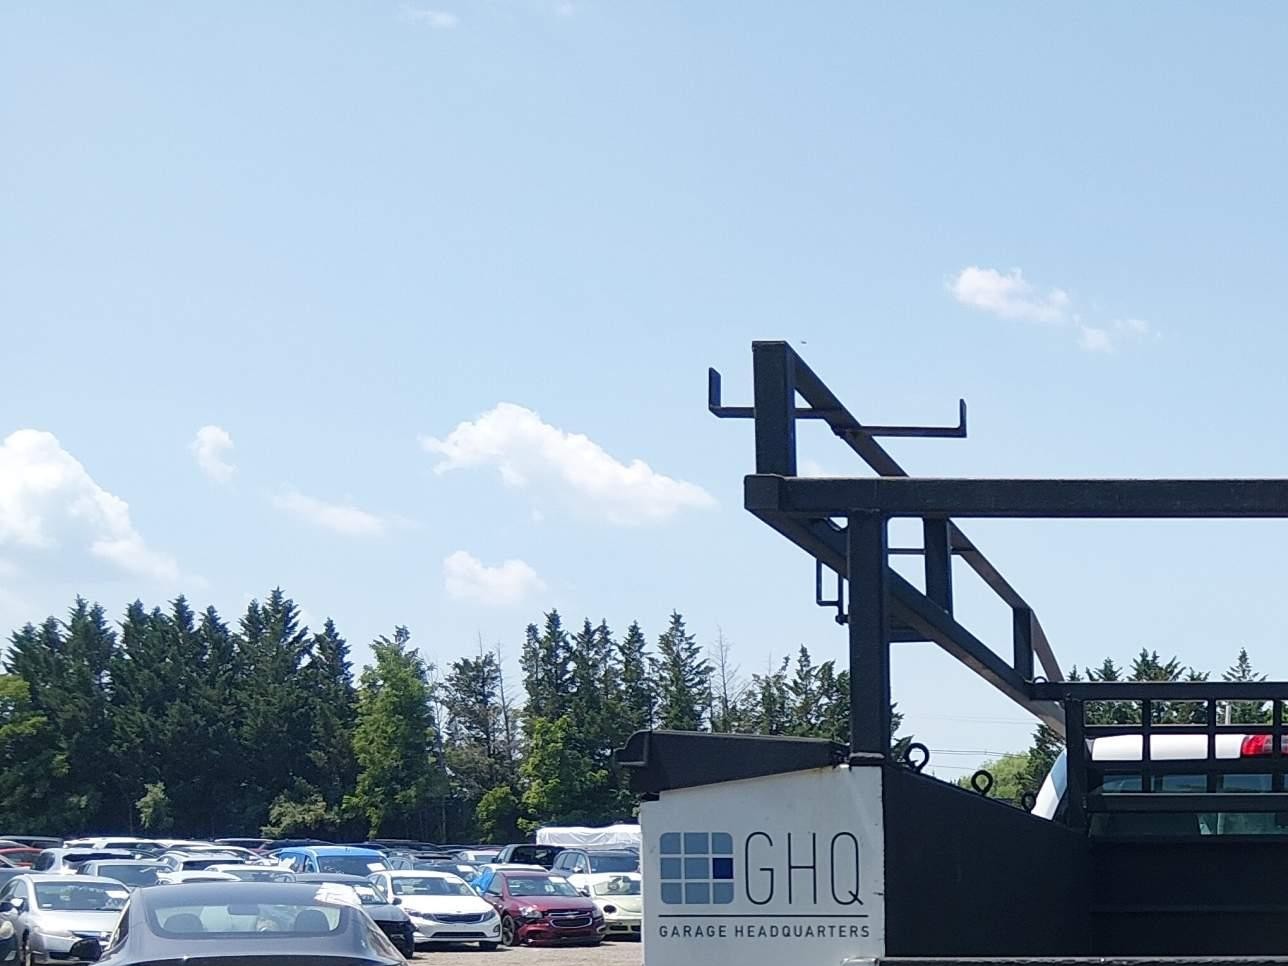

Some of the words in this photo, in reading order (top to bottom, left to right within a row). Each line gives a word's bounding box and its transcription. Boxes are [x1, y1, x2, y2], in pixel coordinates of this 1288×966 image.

[744, 831, 864, 906] GHQ
[659, 925, 728, 938] GARAGE
[734, 924, 870, 938] HEADQUARTERS
